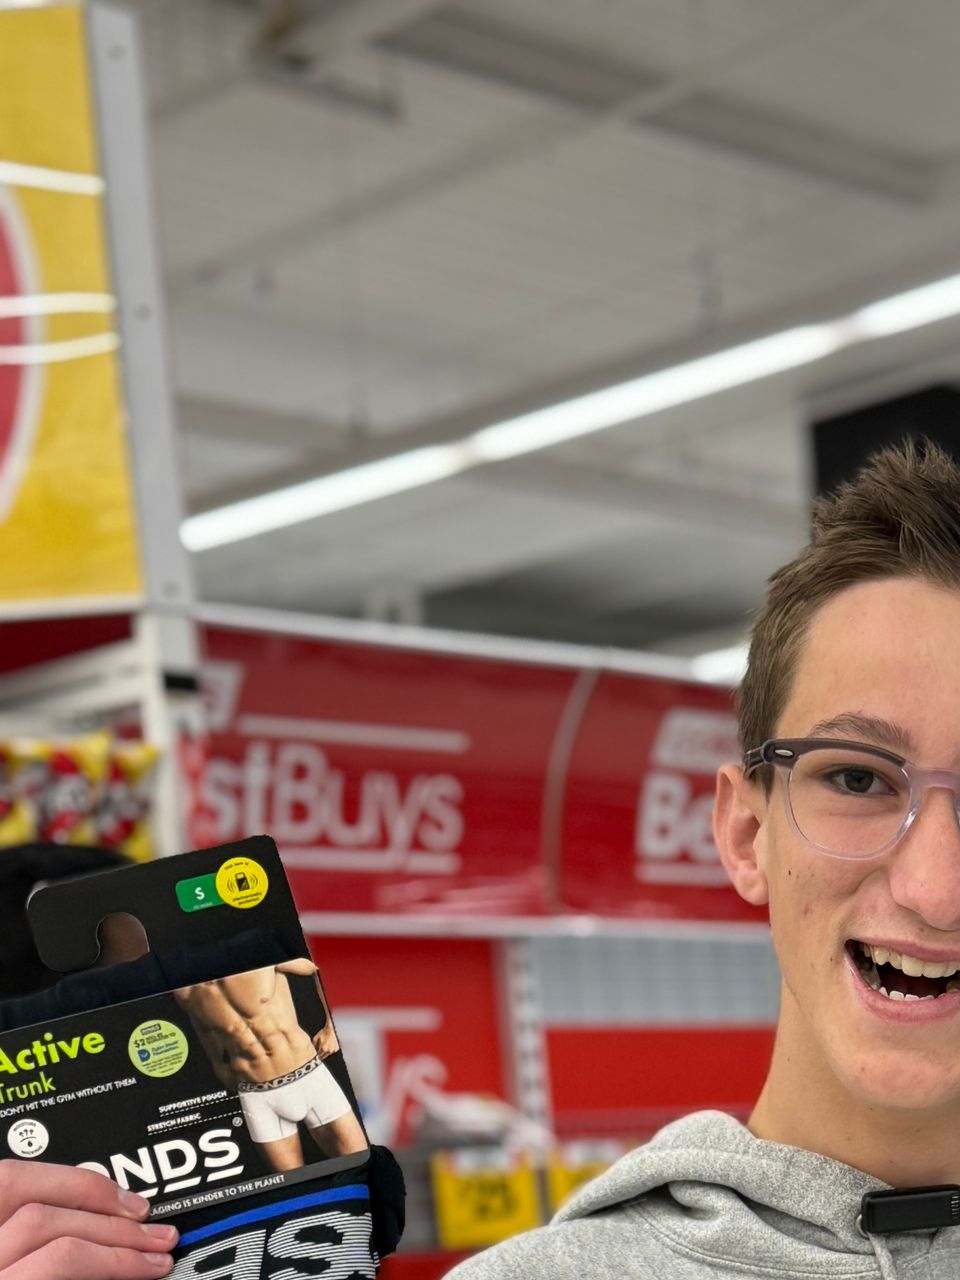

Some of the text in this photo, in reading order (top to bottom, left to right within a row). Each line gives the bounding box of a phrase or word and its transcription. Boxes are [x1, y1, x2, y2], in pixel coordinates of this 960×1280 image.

[195, 887, 205, 900] S
[0, 1032, 106, 1074] Active
[0, 1071, 57, 1104] Trunk
[26, 1101, 39, 1112] HIT
[41, 1096, 56, 1108] THE
[56, 1092, 76, 1104] GYM
[76, 1083, 114, 1098] WITHOUT
[114, 1077, 137, 1090] THEM
[158, 1090, 227, 1114] SUPPORTIVE POUCH
[147, 1112, 202, 1132] STRETCH FABRIC
[76, 1128, 240, 1190] NDS
[183, 1199, 192, 1209] IS
[193, 1191, 224, 1206] KINDER
[225, 1187, 237, 1199] TO
[238, 1182, 254, 1194] THE
[254, 1175, 286, 1190] PLANET
